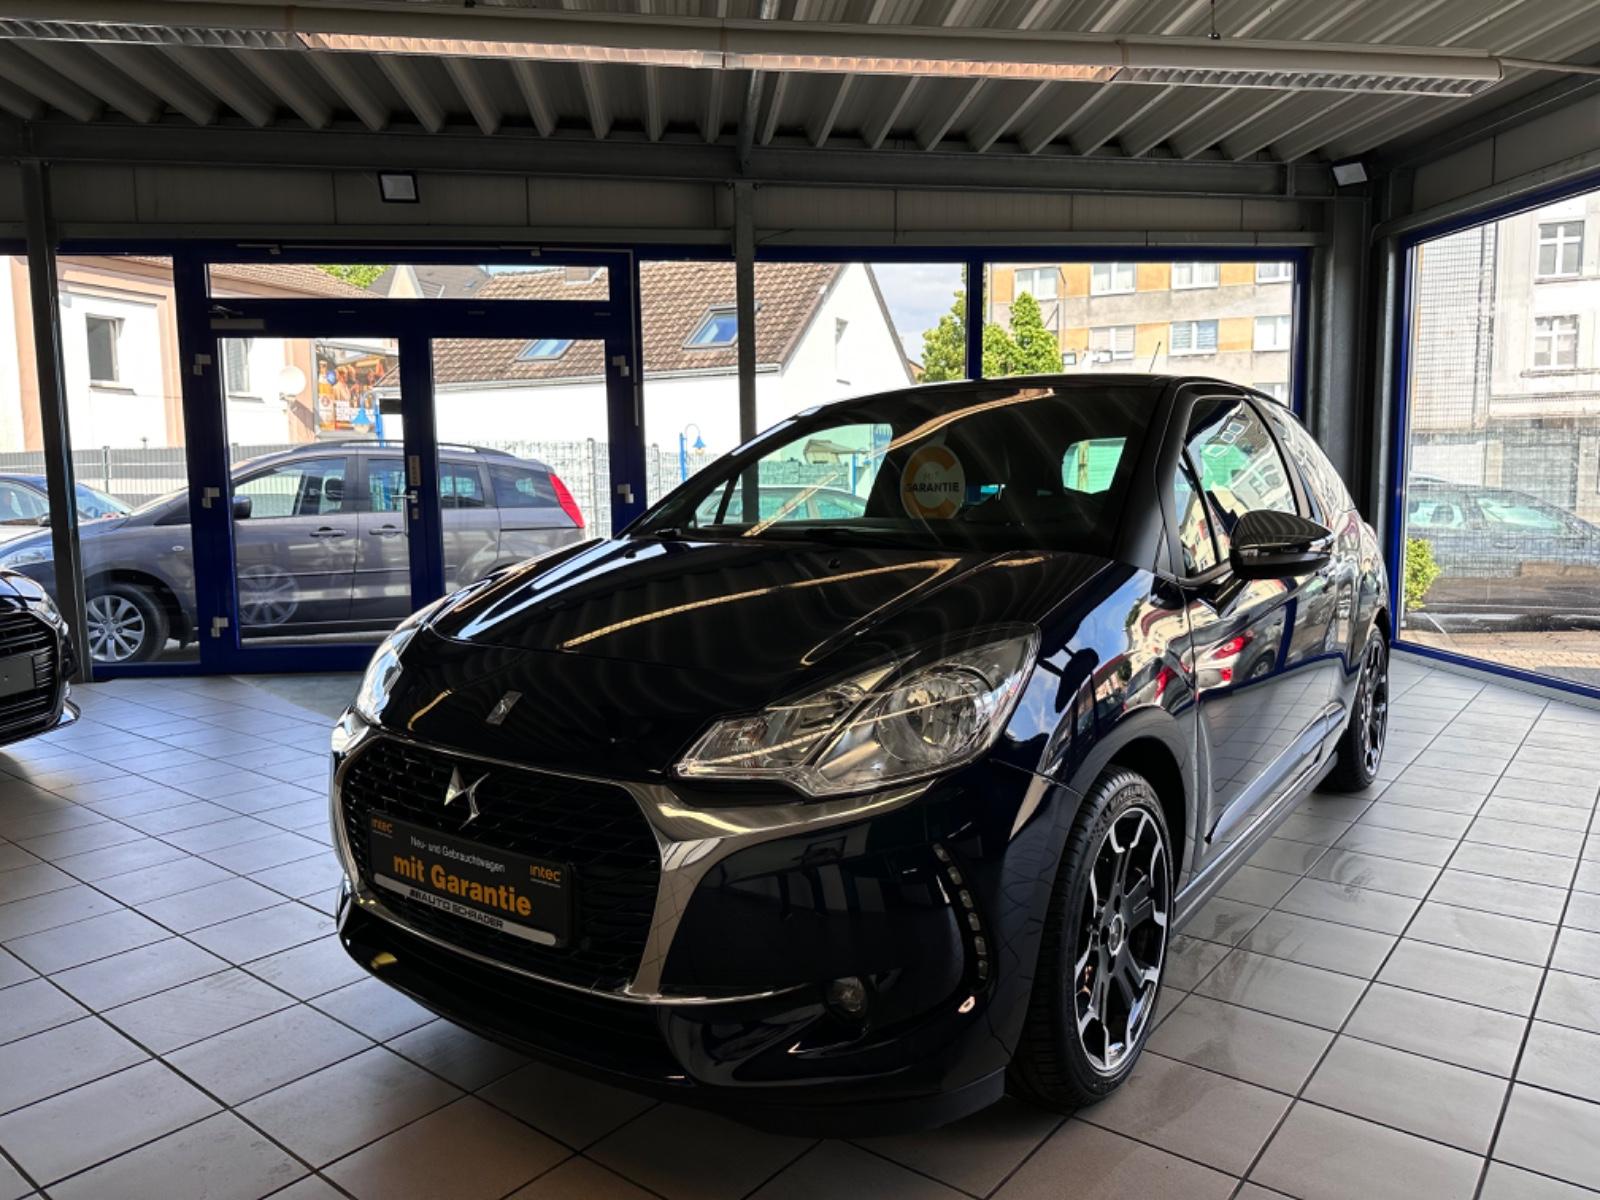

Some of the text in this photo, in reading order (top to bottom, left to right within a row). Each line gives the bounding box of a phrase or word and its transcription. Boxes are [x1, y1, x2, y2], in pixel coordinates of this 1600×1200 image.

[442, 845, 506, 874] Gebrauchtwagen
[393, 854, 533, 917] mit Garantie
[529, 863, 562, 884] intec
[452, 903, 505, 929] SCHRADER
